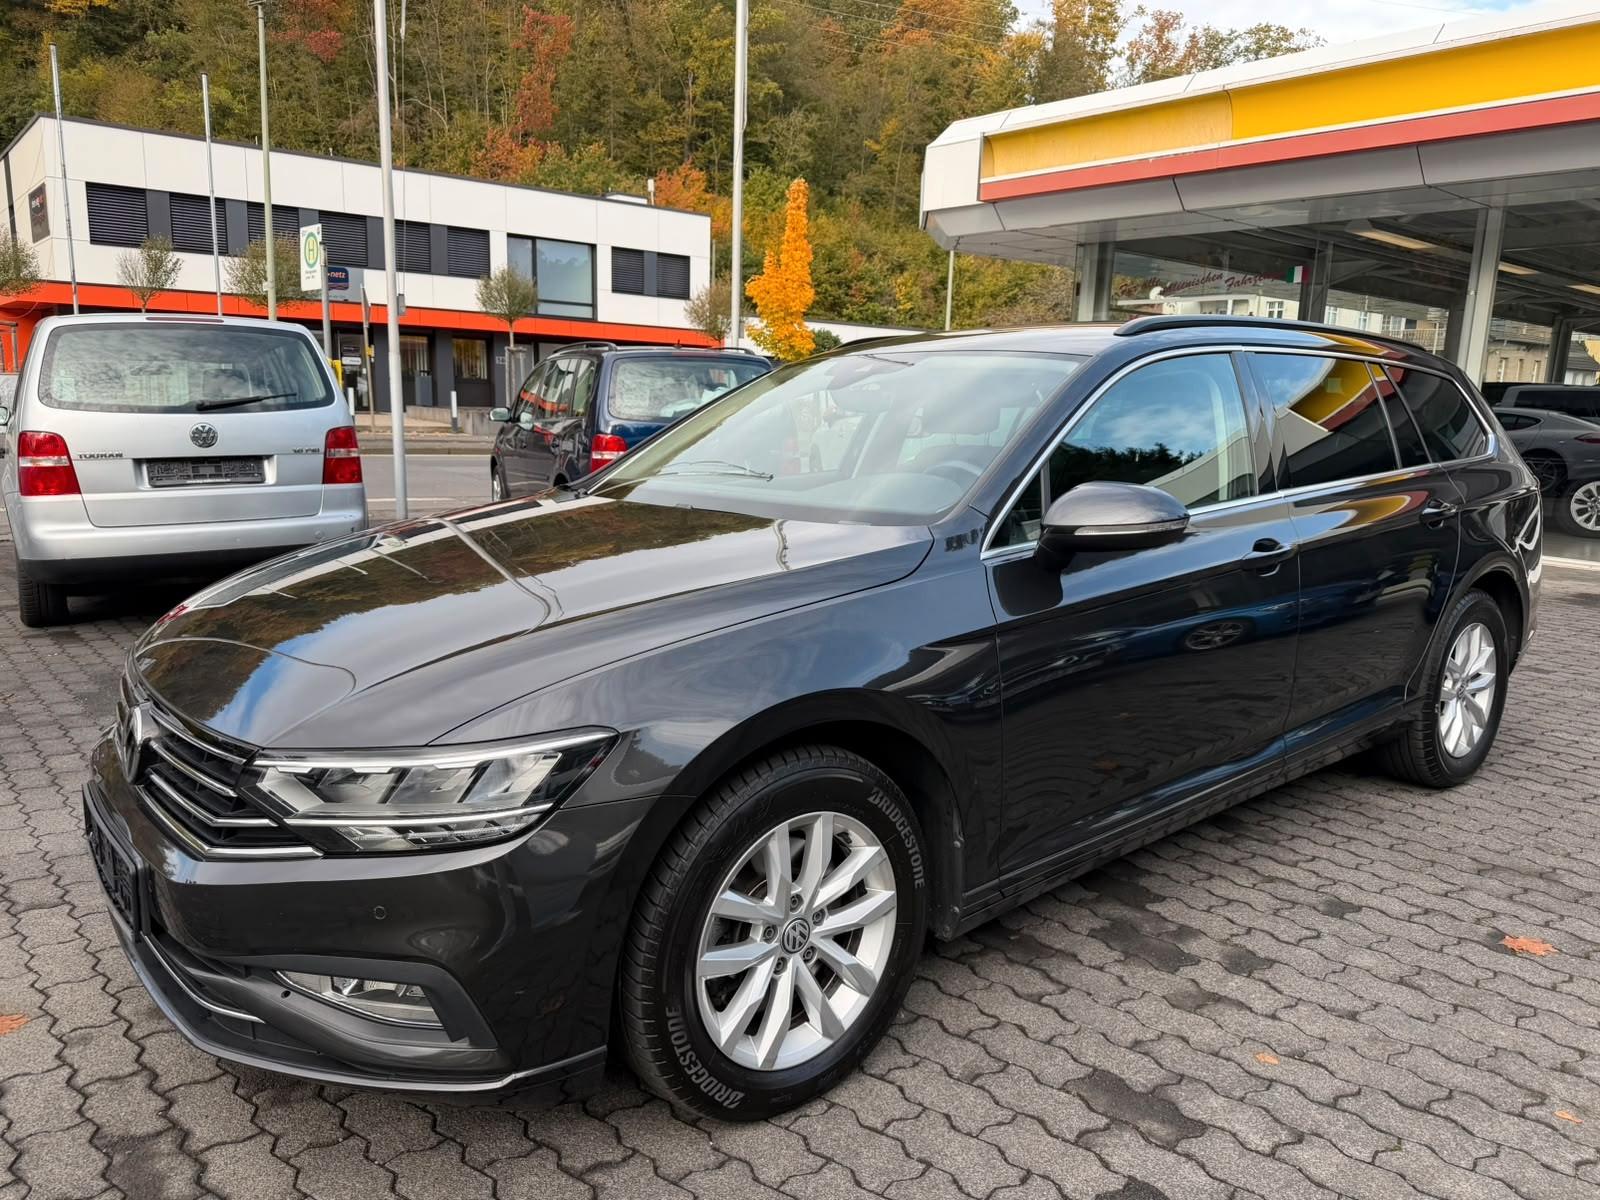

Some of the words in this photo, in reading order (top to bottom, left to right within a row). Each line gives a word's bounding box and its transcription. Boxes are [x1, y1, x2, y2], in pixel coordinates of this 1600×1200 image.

[1225, 271, 1286, 291] Fahrze
[867, 787, 925, 889] BRIDGESTONE
[665, 1006, 745, 1109] BRIDGESTONE
